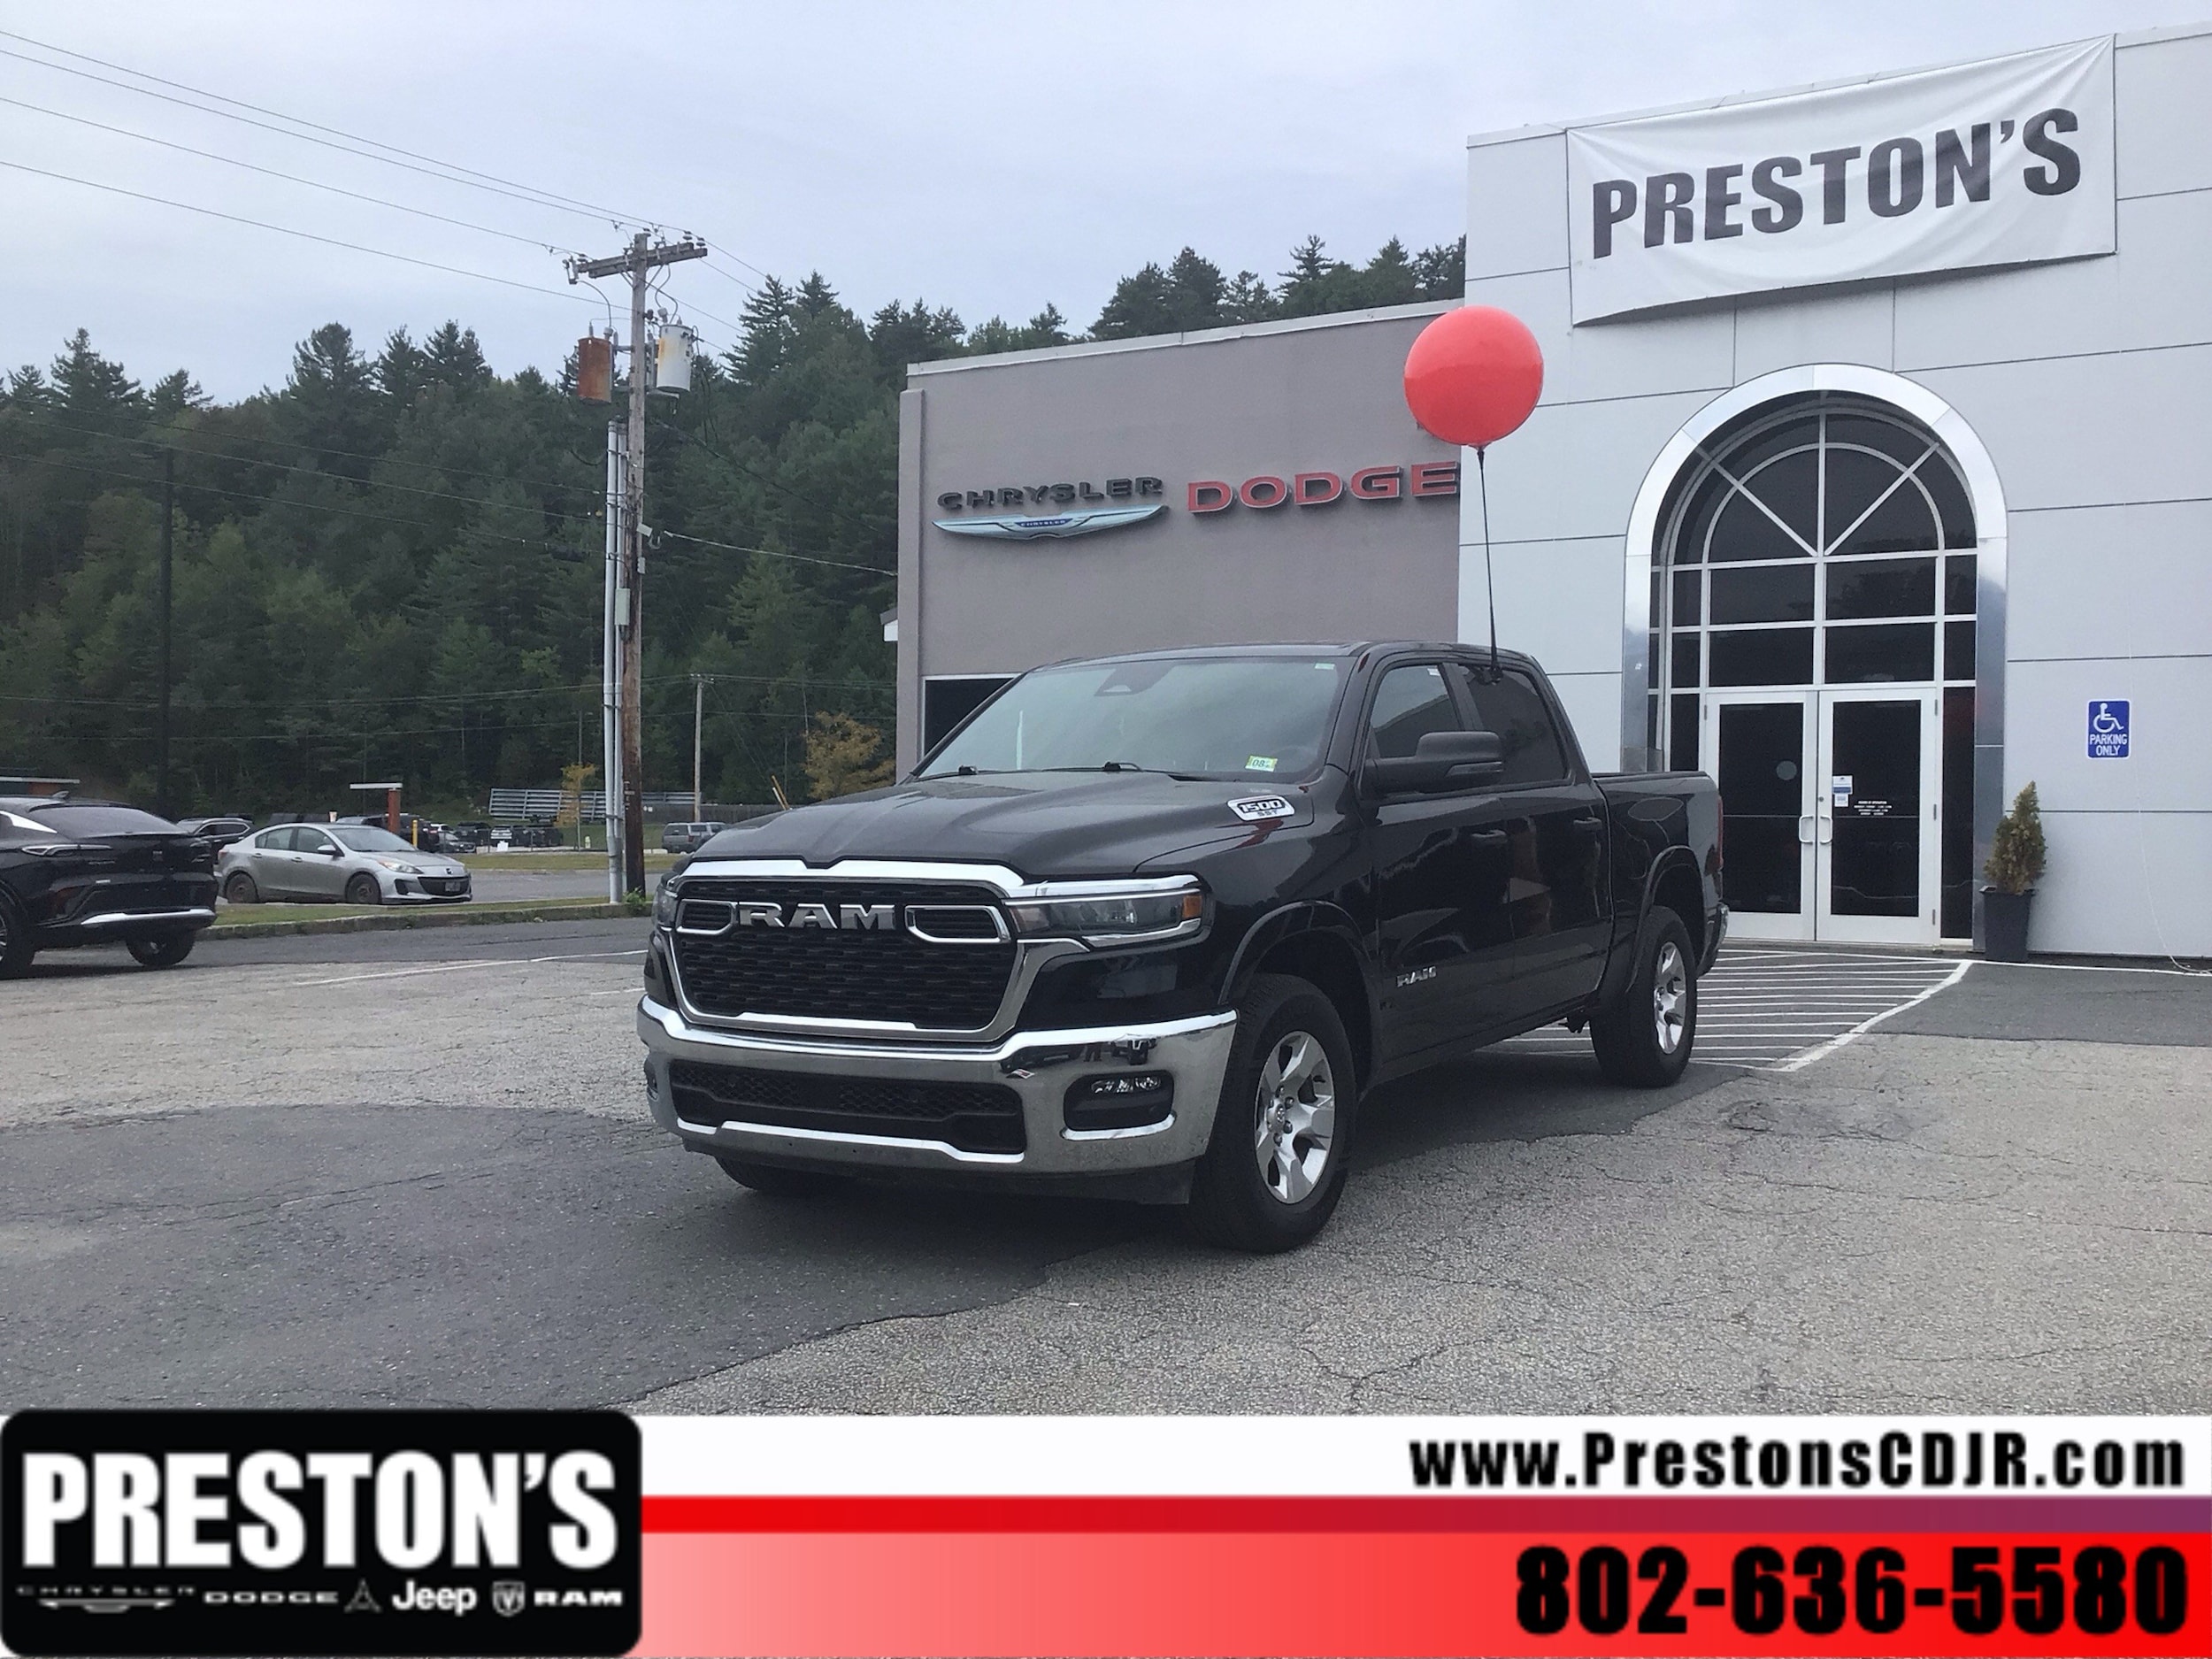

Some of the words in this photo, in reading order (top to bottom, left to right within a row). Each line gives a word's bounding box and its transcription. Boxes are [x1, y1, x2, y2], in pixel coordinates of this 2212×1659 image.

[1593, 107, 2081, 259] PRESTON'S
[937, 476, 1164, 511] CHRYSLER
[1187, 460, 1460, 515] DODGE
[2089, 733, 2127, 744] PARKING
[2095, 745, 2120, 756] ONLY
[1240, 800, 1282, 812] 1500
[738, 901, 896, 930] RAM
